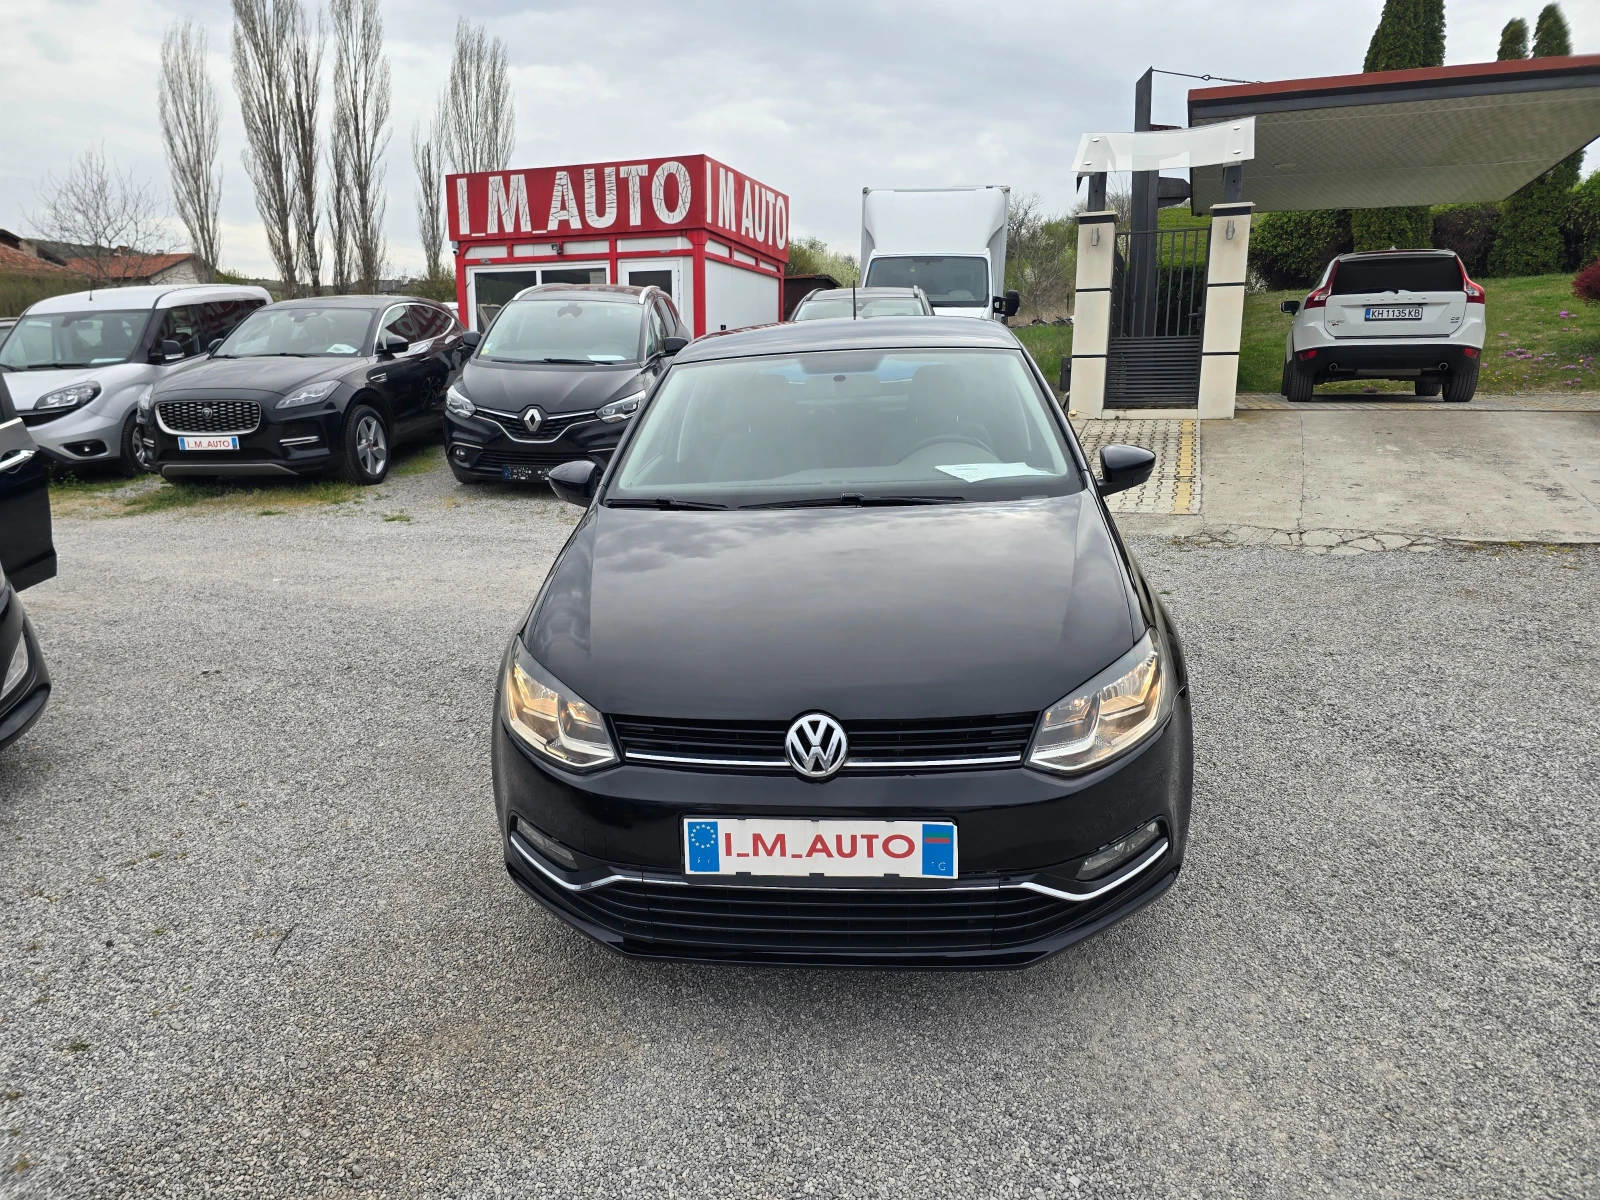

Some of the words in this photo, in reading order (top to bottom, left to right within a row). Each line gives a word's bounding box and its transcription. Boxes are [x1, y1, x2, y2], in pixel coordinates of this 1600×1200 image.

[706, 161, 713, 224] I
[718, 167, 737, 232] M
[741, 179, 788, 250] AUTO
[1386, 309, 1407, 318] 1135
